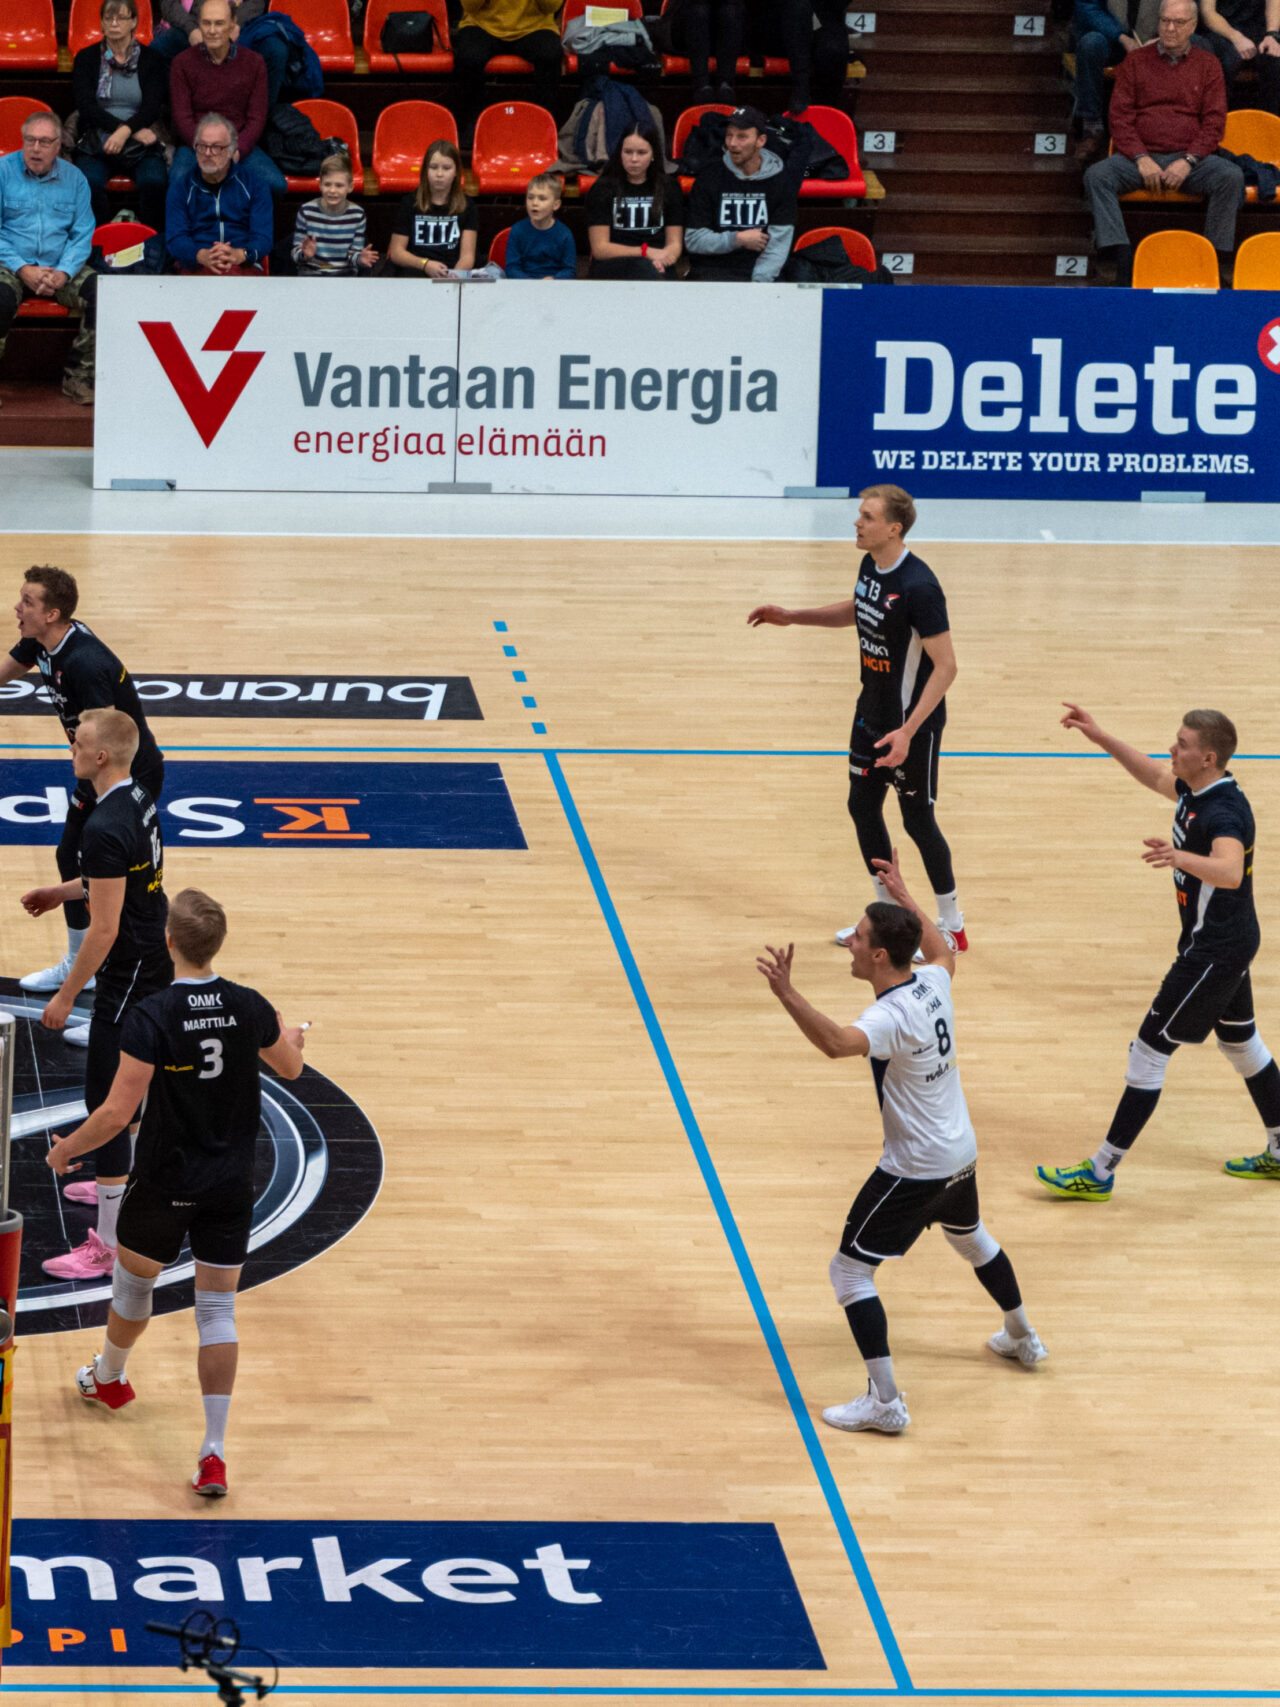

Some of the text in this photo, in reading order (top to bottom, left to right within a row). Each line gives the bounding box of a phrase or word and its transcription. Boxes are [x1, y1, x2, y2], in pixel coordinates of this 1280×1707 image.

[853, 14, 867, 31] 4
[1022, 17, 1036, 33] 4
[872, 133, 886, 150] 3
[1043, 135, 1057, 152] 3
[719, 198, 769, 226] ETTA
[414, 220, 461, 244] ETTA
[890, 255, 905, 272] 2
[1064, 257, 1079, 274] 2
[293, 350, 779, 425] Vantaan Energia
[872, 337, 1258, 435] Delete
[293, 424, 607, 462] energiaa elämään
[872, 449, 1256, 475] WE DELETE YOUR PROBLEMS.
[867, 579, 881, 602] 13
[183, 1015, 238, 1032] MARTTILA
[934, 1017, 952, 1057] 8
[197, 1037, 225, 1080] 3
